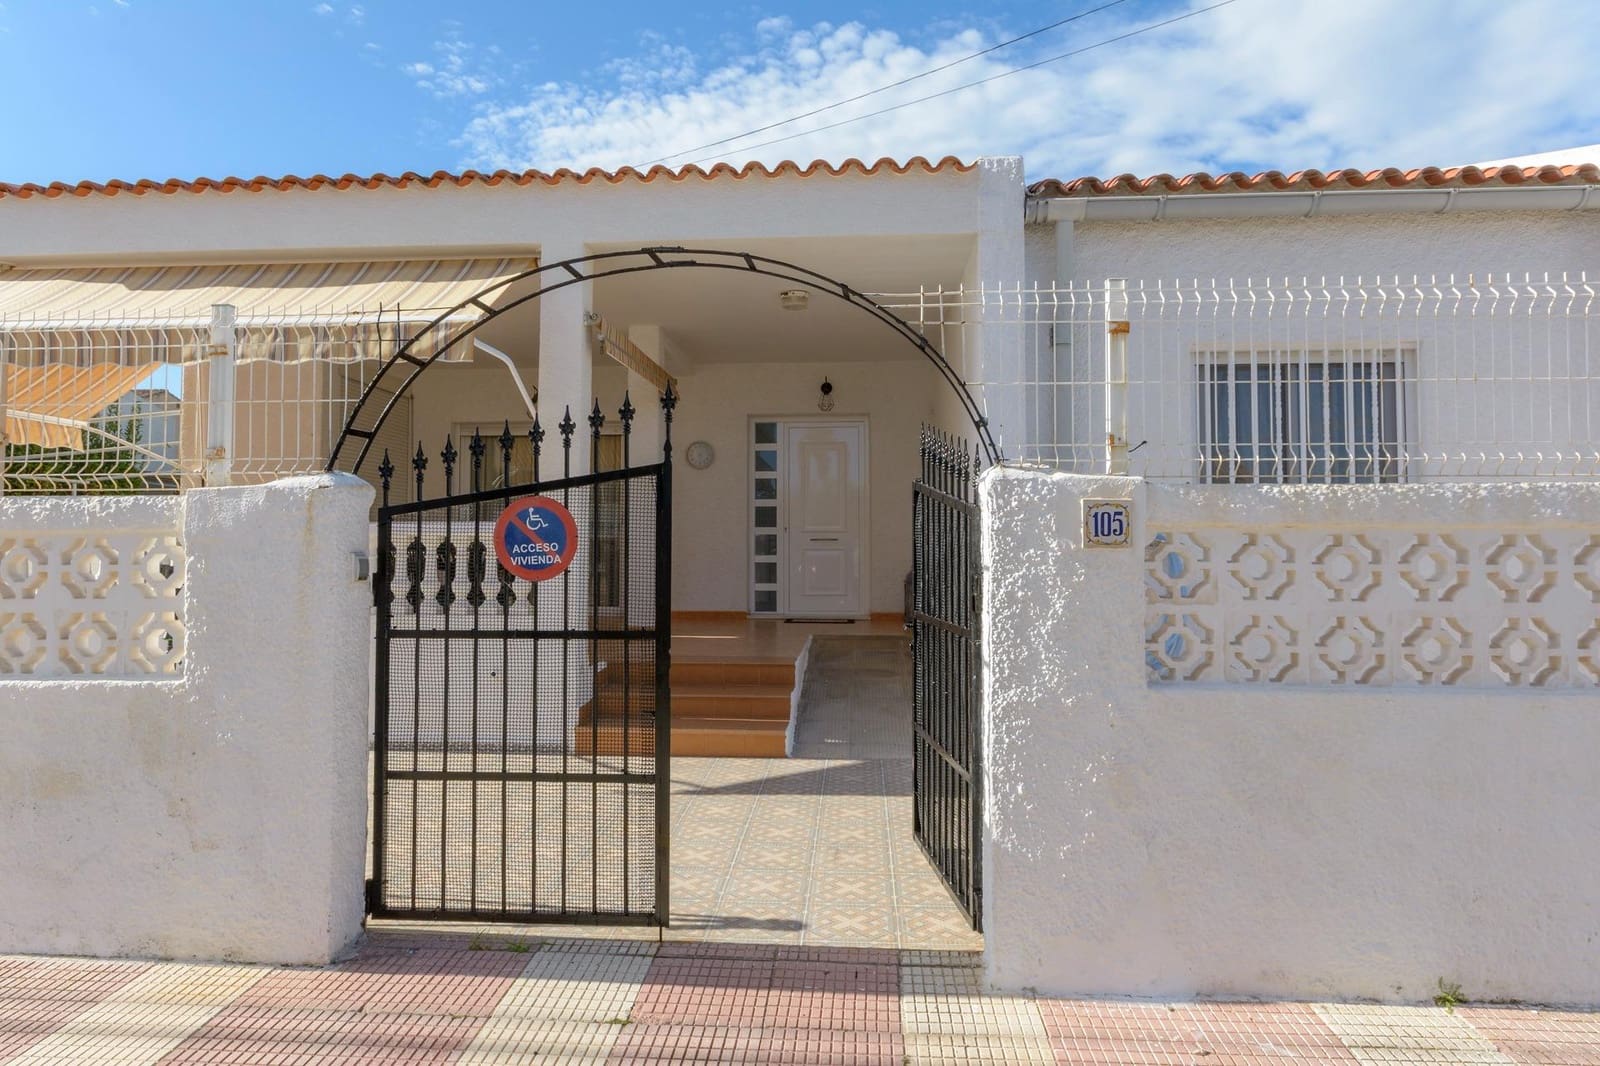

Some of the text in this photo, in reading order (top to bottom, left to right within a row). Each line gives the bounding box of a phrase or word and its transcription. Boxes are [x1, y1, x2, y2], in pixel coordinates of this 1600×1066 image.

[1092, 511, 1124, 538] 105
[512, 542, 559, 554] ACCESO
[510, 554, 562, 566] VIVIENDA
